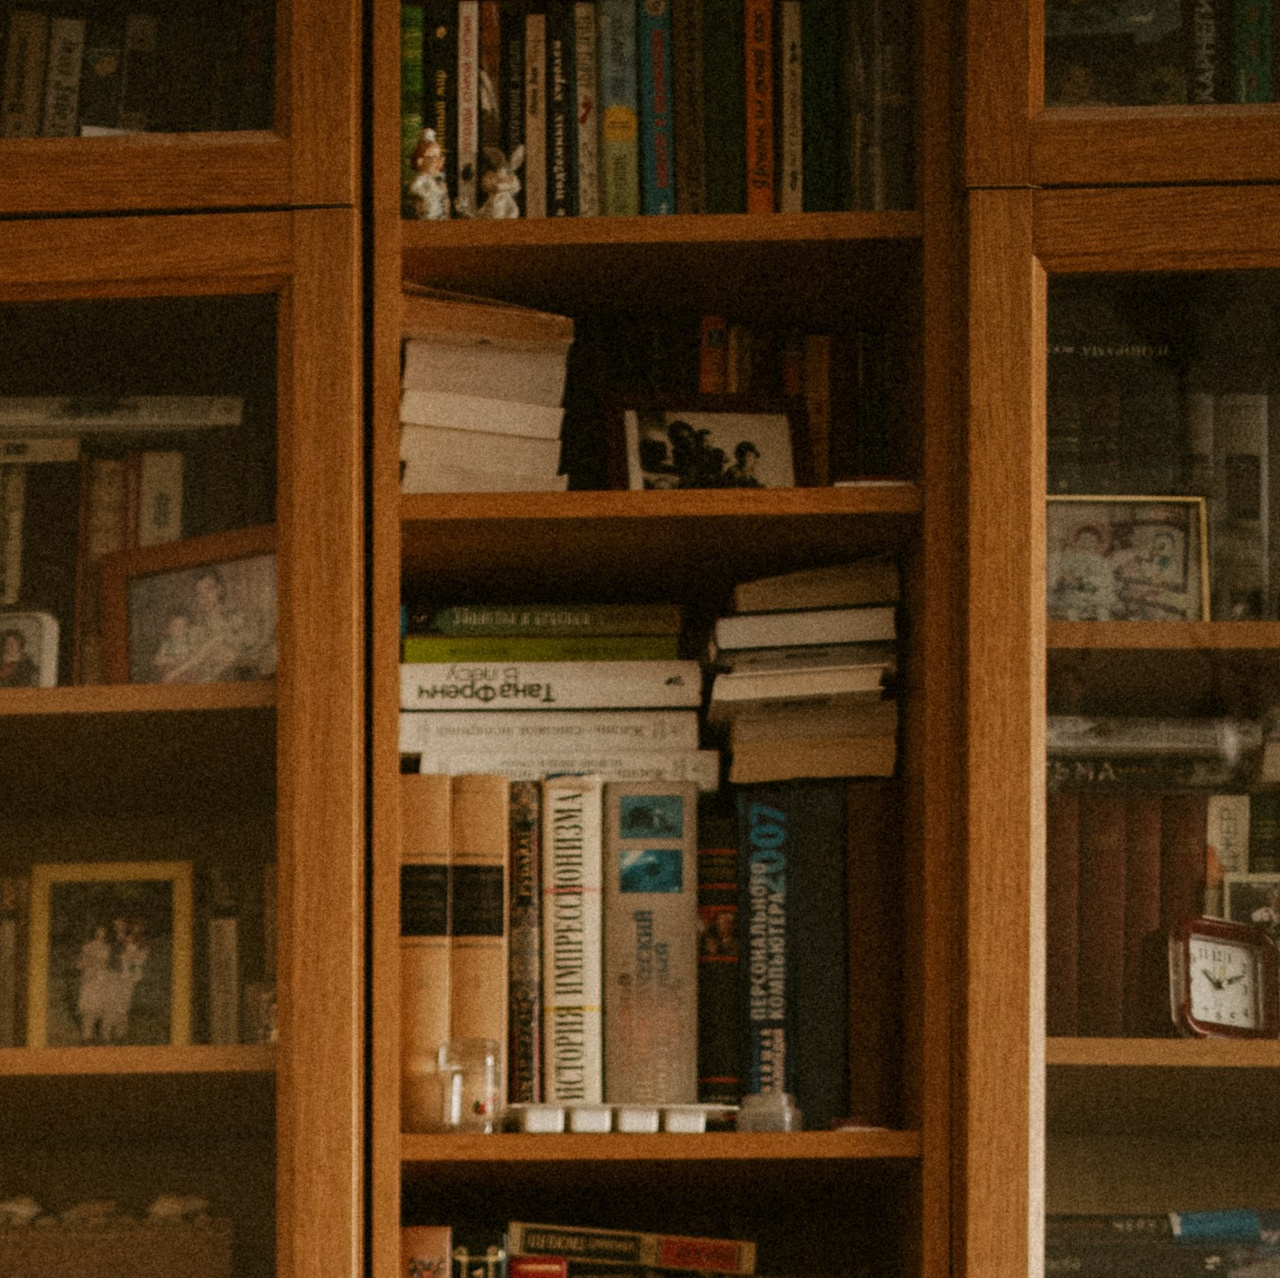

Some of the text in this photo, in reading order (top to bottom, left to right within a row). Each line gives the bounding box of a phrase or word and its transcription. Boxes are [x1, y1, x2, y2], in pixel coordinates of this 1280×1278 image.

[417, 681, 556, 703] Тана Френч
[749, 802, 787, 893] 2007
[552, 793, 586, 1101] ИСТОРИЯ ИМПРЕССИОНИЗМА
[749, 861, 767, 1021] ПЕРСОНАЛЬНОГО
[768, 891, 786, 1021] КОМПЬЮТЕРА
